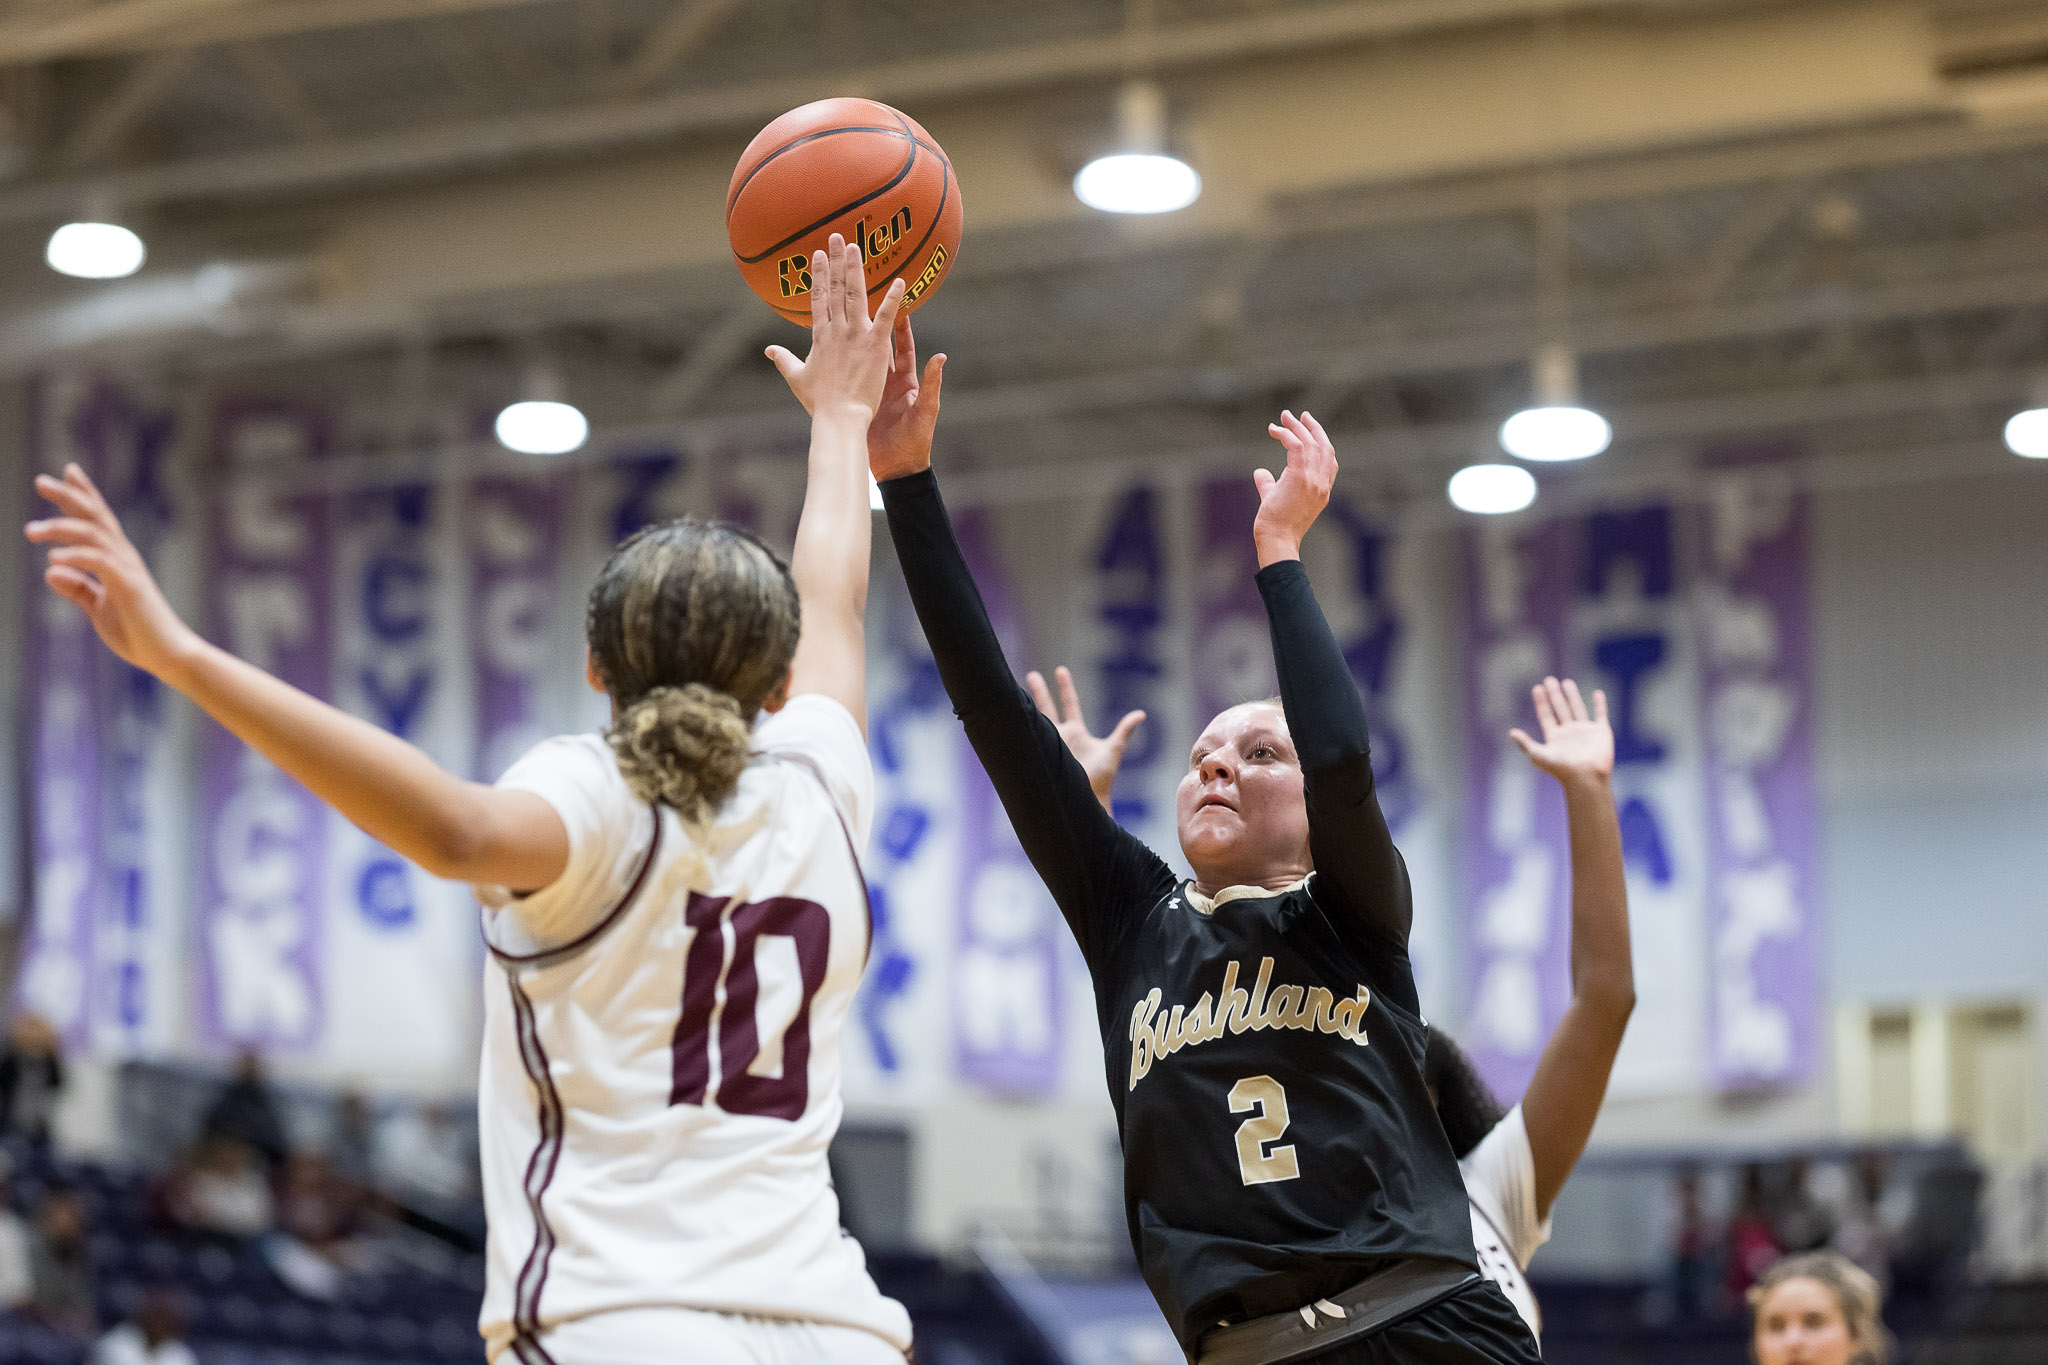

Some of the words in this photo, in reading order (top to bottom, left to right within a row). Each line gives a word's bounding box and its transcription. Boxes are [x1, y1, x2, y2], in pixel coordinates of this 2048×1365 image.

[778, 205, 912, 298] Bden
[669, 890, 830, 1121] 10
[1129, 956, 1370, 1092] Bushland
[1227, 1074, 1300, 1186] 2
